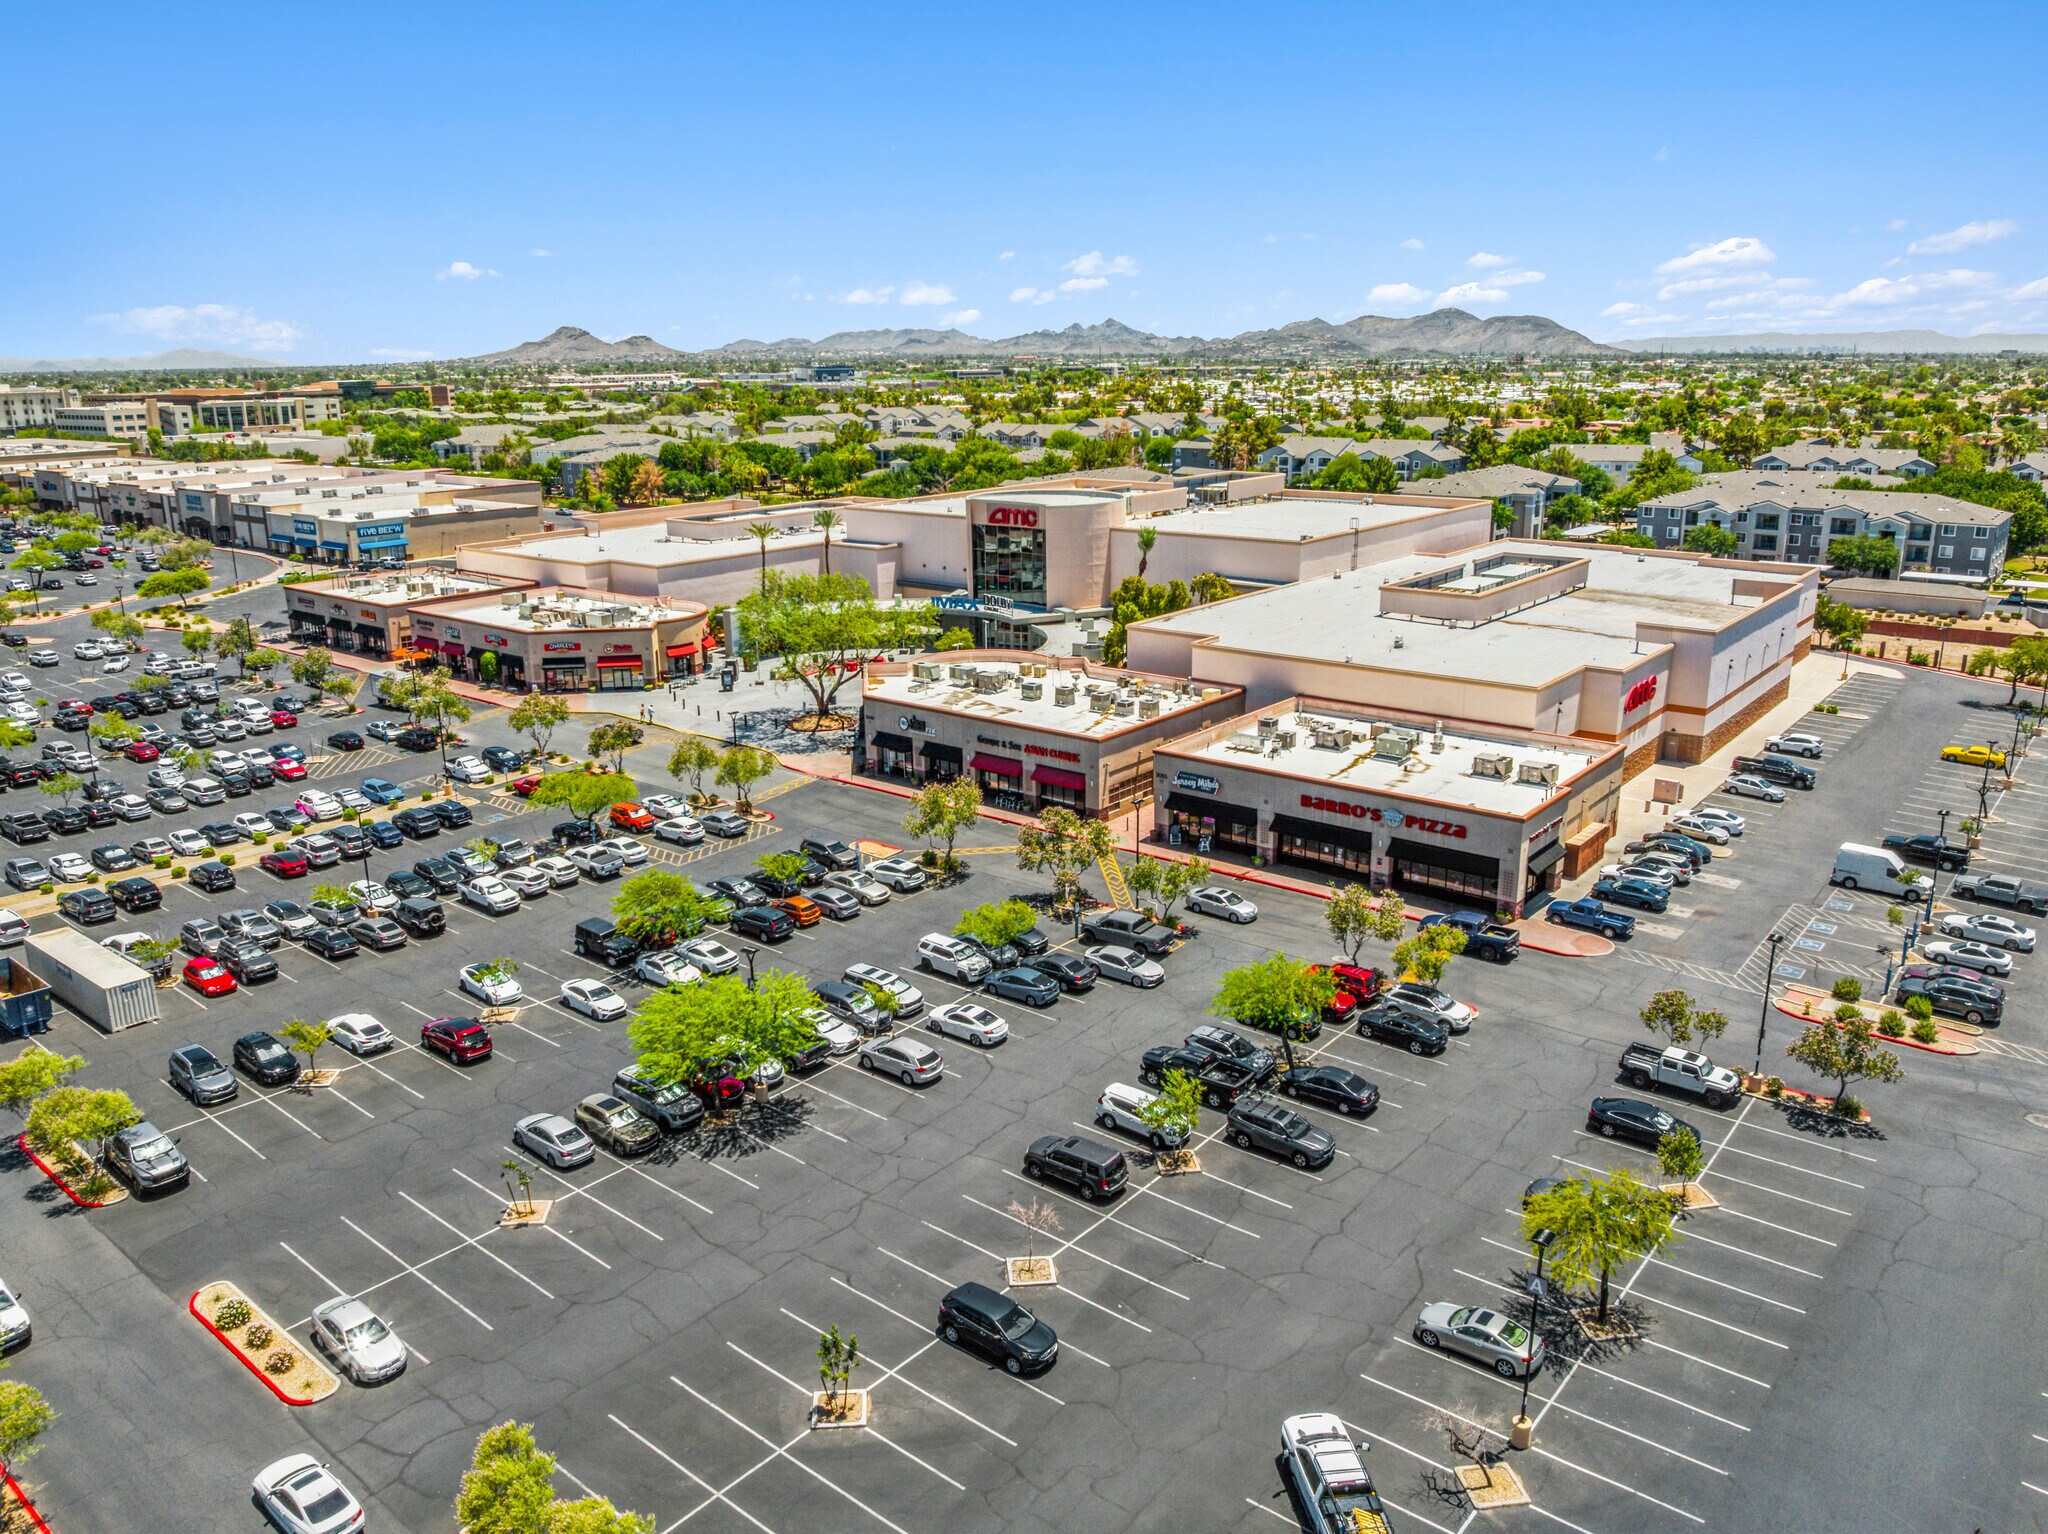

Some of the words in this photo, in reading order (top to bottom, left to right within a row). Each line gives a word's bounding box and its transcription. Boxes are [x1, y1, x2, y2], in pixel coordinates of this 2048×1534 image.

[930, 596, 980, 611] IMAX
[984, 594, 1013, 610] DOLBY
[1024, 743, 1049, 757] ASIAN
[1172, 776, 1197, 788] Jersey
[1197, 778, 1219, 789] Mike's
[1934, 837, 1945, 848] A
[1530, 1278, 1544, 1296] A
